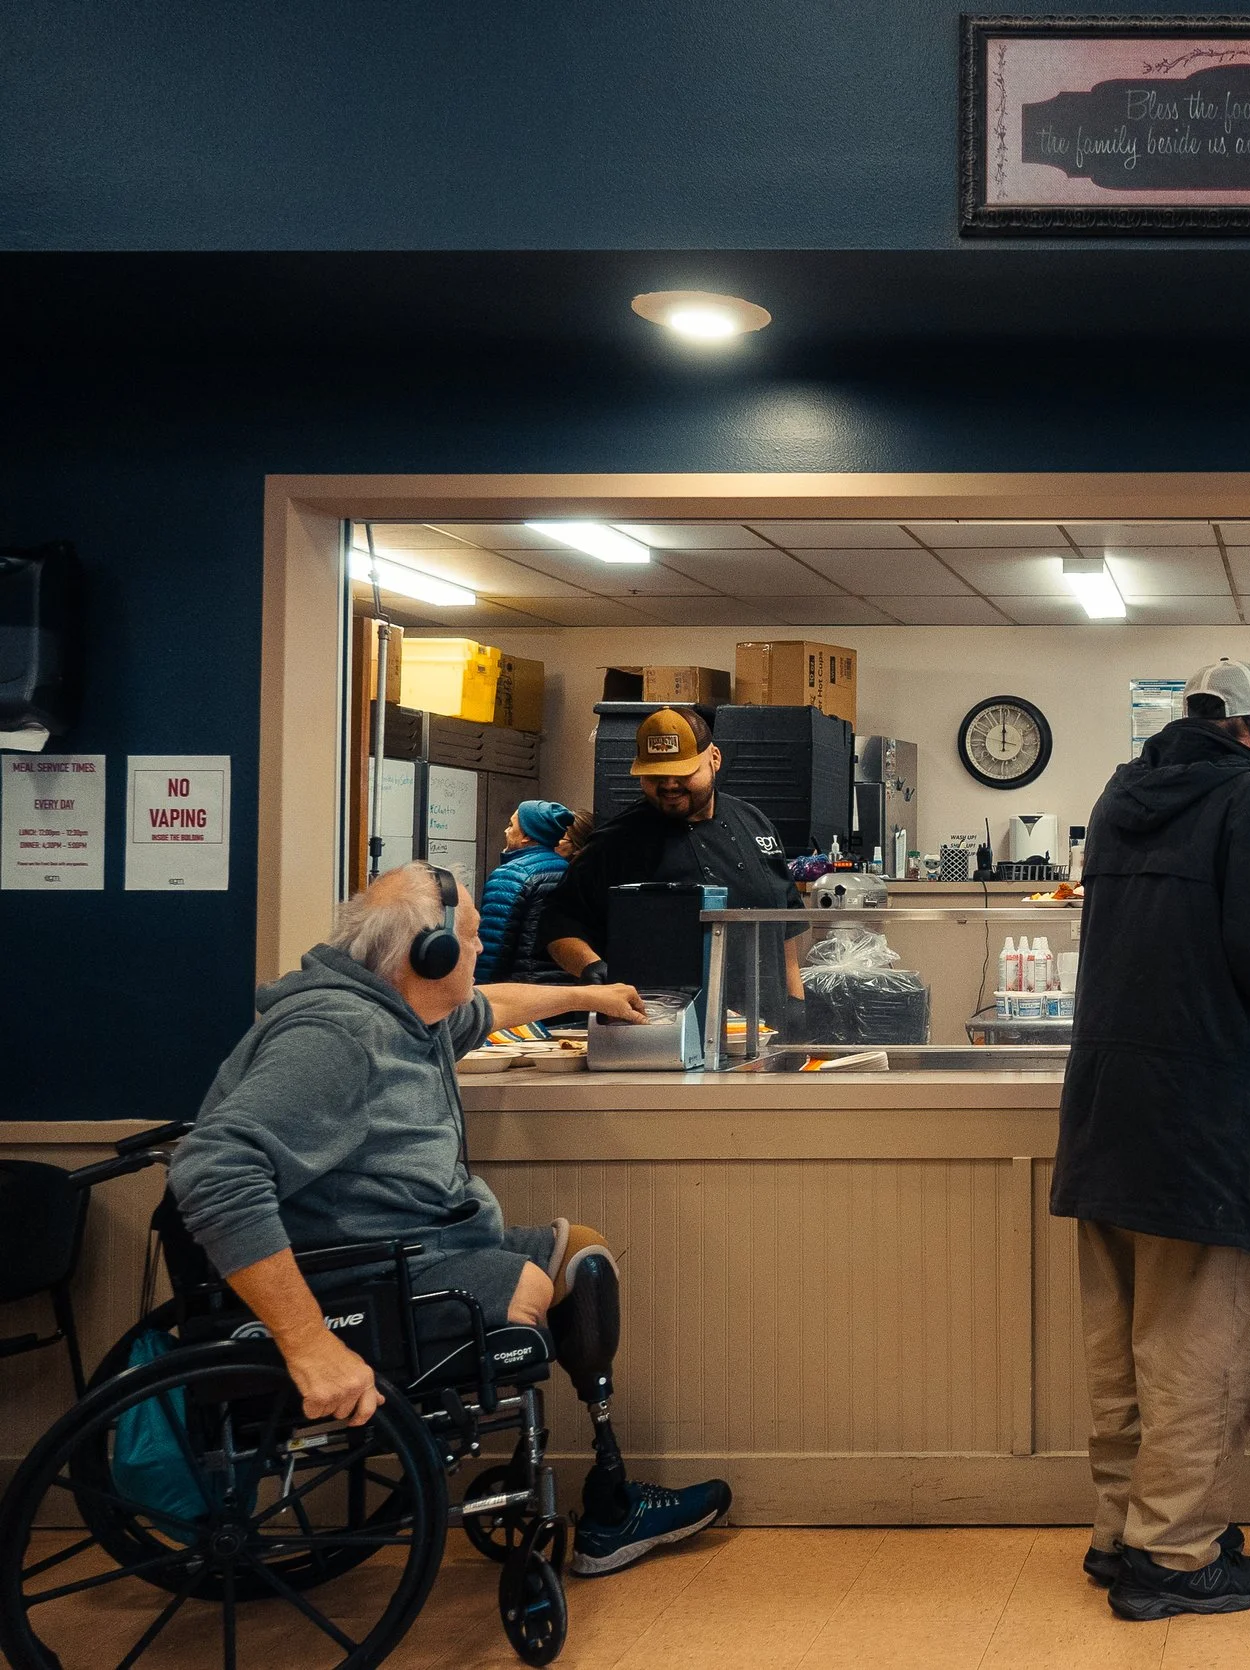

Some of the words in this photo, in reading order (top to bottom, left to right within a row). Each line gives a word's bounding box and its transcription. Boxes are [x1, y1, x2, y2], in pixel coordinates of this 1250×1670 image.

[1125, 89, 1179, 120] Bless
[1184, 91, 1218, 120] the
[1036, 125, 1070, 154] the
[1076, 125, 1142, 170] family
[1147, 125, 1201, 154] beside
[13, 762, 35, 773] MEAL
[36, 762, 70, 773] SERVICE
[168, 778, 190, 797] NO
[34, 800, 58, 810] EVERY
[60, 800, 75, 810] DAY
[150, 808, 207, 828] VAPING
[493, 1346, 533, 1361] COMFORT
[504, 1355, 524, 1364] CURVE
